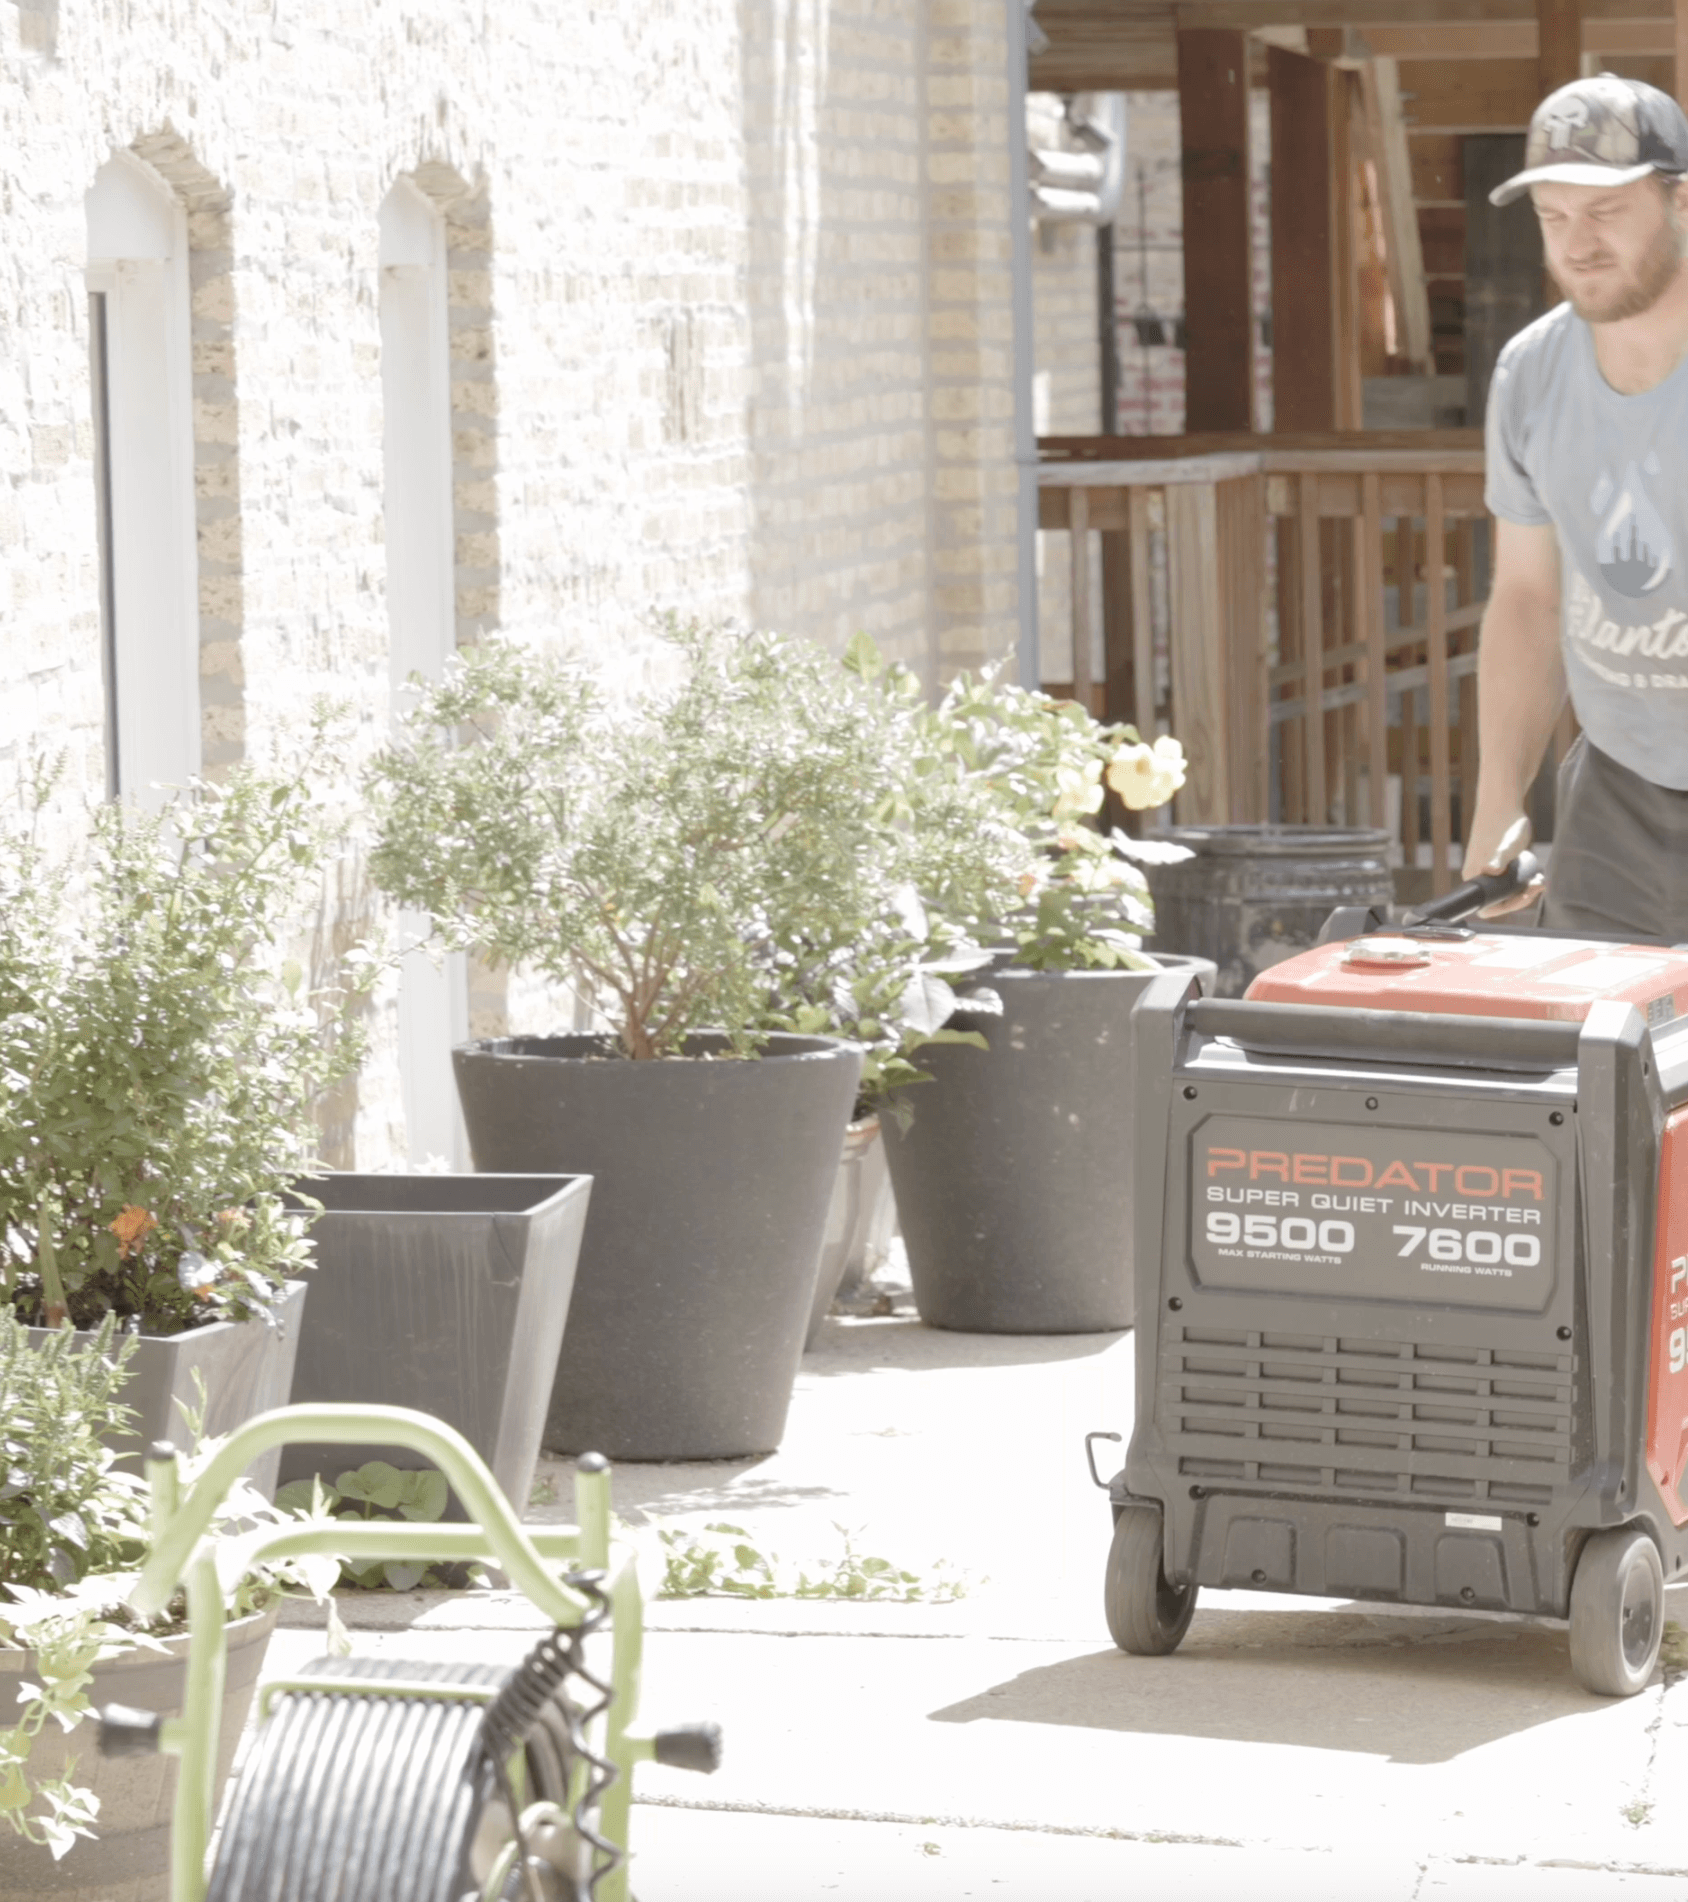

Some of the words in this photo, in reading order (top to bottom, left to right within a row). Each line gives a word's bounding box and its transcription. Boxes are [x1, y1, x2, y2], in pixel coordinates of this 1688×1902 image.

[1207, 1147, 1544, 1200] PREDATOR
[1207, 1186, 1299, 1207] SUPER
[1311, 1194, 1394, 1213] QUIET
[1404, 1200, 1541, 1225] INVERTER
[1206, 1211, 1355, 1253] 9500
[1393, 1225, 1541, 1267] 7600
[1218, 1248, 1244, 1257] MAX
[1246, 1250, 1302, 1262] STARTING
[1304, 1254, 1342, 1265] WATTS
[1420, 1263, 1472, 1274] RUNNING
[1474, 1267, 1513, 1277] WATTS
